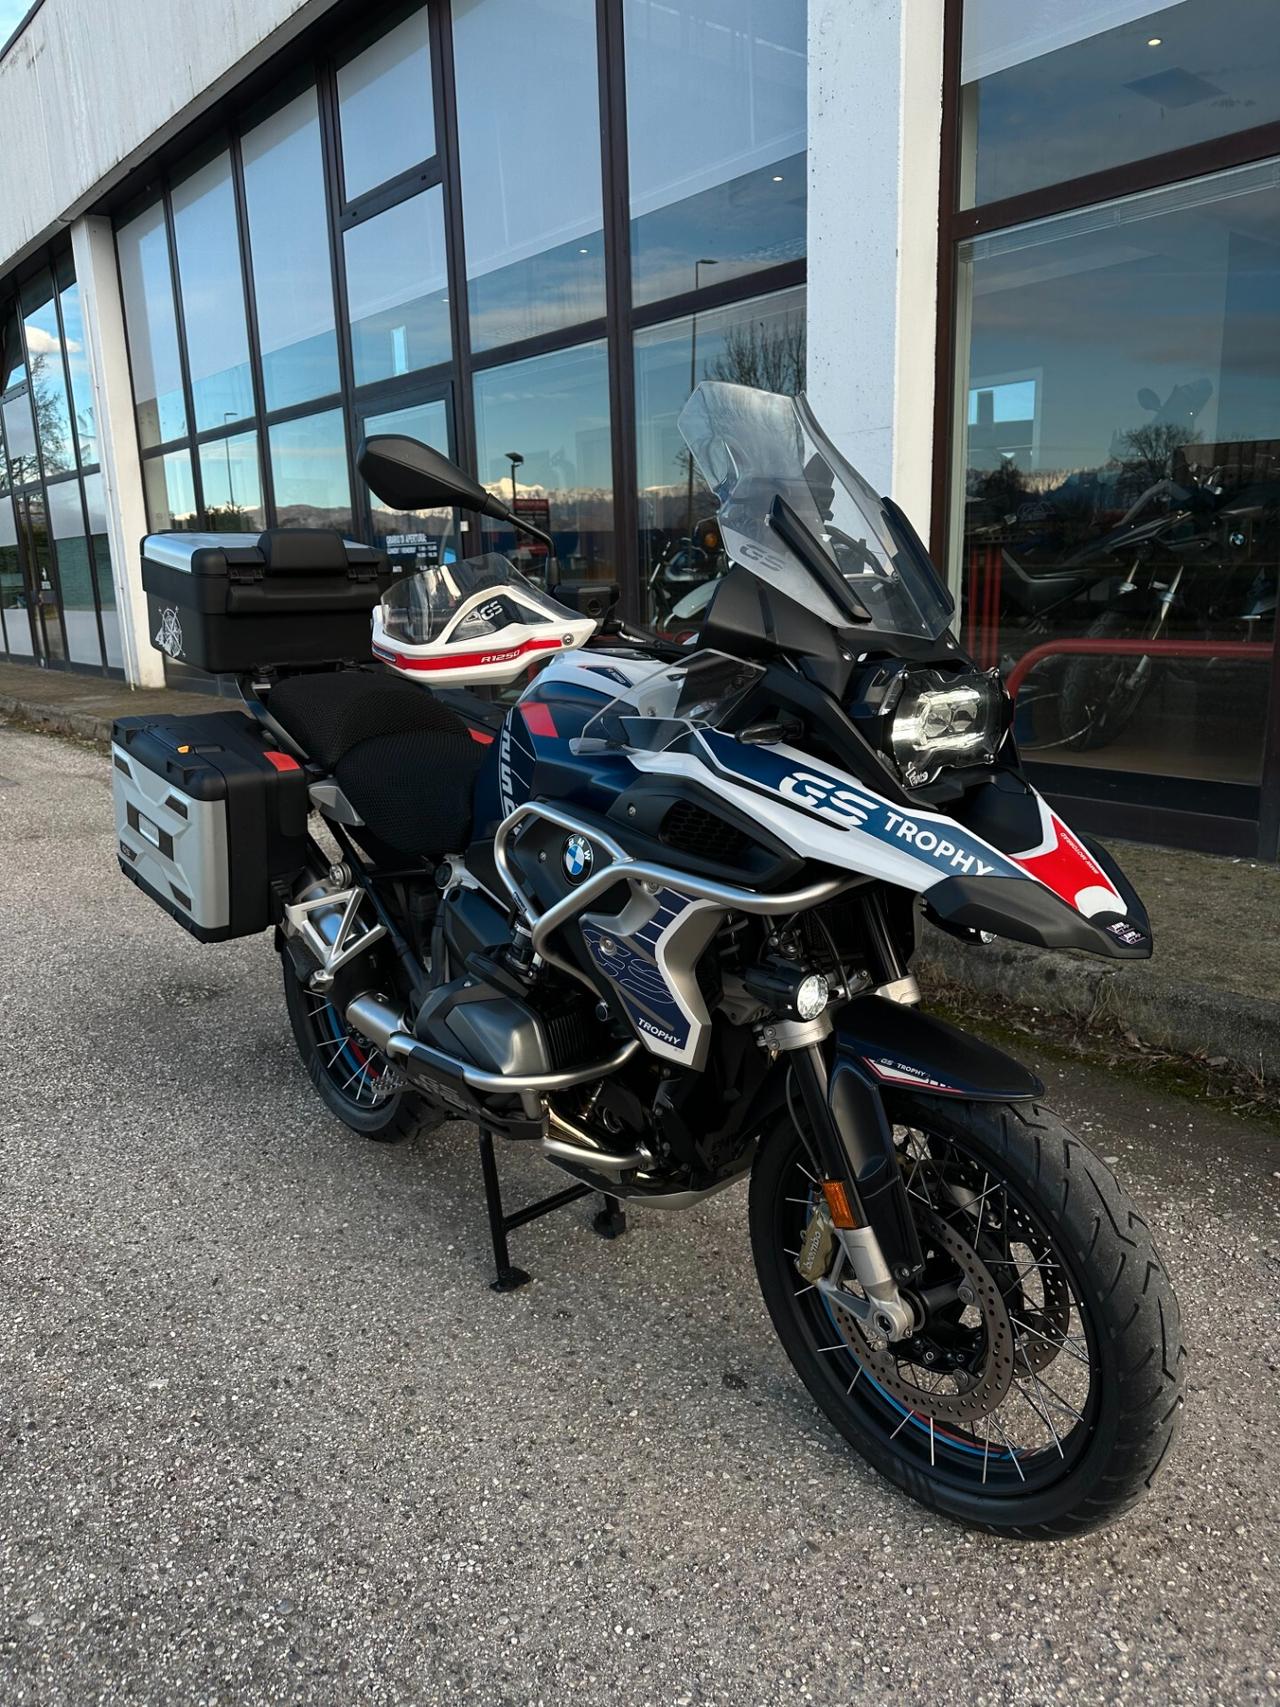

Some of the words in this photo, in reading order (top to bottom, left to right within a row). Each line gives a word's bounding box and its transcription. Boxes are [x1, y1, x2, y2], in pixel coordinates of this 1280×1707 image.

[739, 543, 784, 572] GS
[480, 600, 503, 620] GS
[779, 772, 880, 826] GS
[884, 811, 994, 876] TROPHY
[638, 1017, 681, 1045] TROPHY
[897, 1062, 926, 1077] TROPHY
